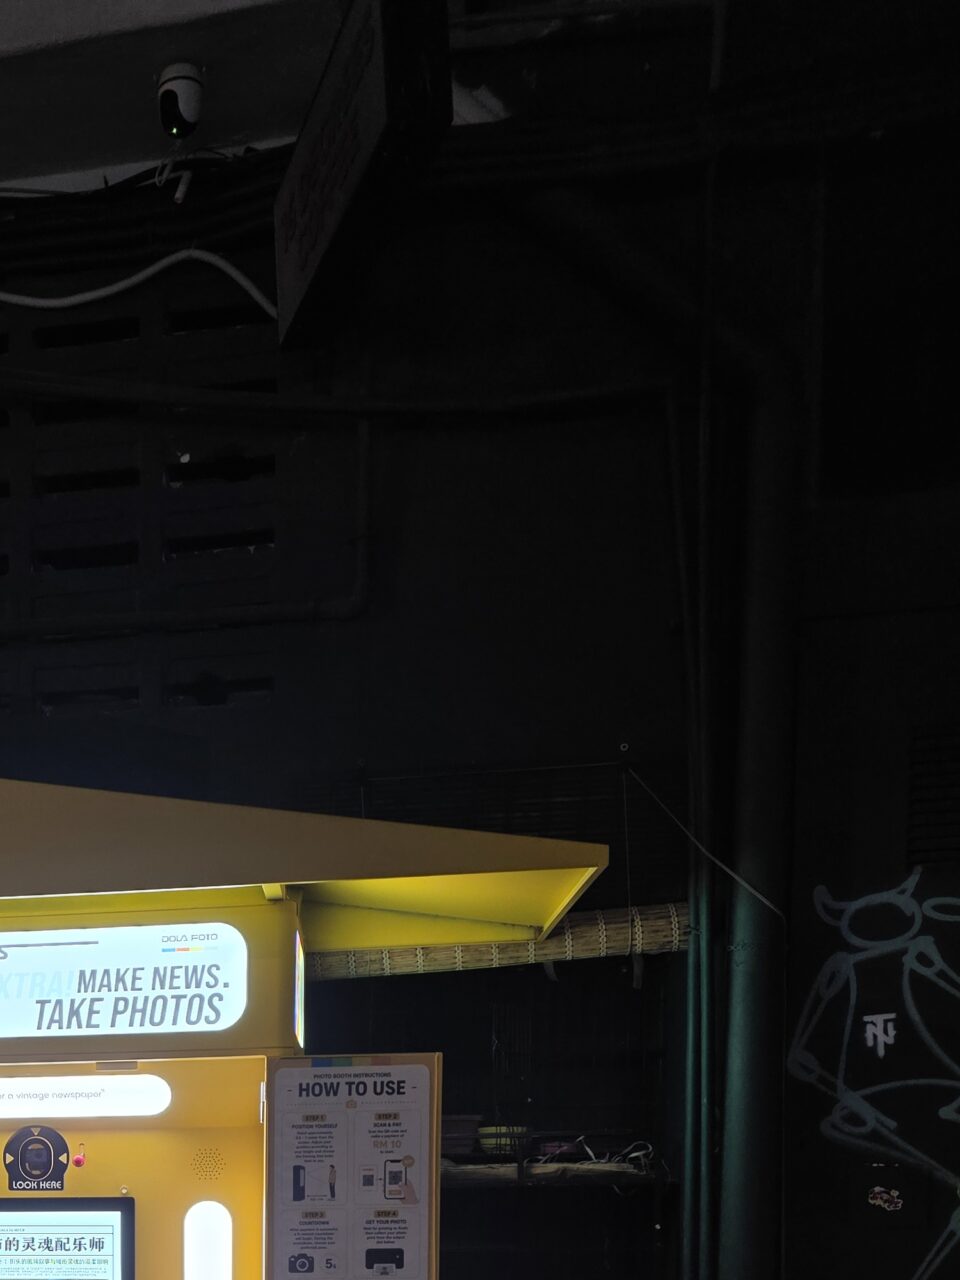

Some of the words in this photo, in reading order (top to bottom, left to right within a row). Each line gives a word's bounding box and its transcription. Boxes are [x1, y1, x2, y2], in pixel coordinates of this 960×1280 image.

[162, 935, 189, 943] DOLA
[191, 933, 219, 942] FOTO
[77, 967, 145, 995] MAKE
[151, 963, 230, 991] NEWS.
[35, 997, 105, 1031] TAKE
[110, 992, 225, 1028] PHOTOS
[298, 1081, 340, 1097] HOW
[345, 1081, 368, 1096] TO
[373, 1080, 406, 1096] USE
[17, 1090, 50, 1102] vintage
[373, 1140, 388, 1149] RM
[391, 1140, 402, 1149] 10
[12, 1180, 38, 1190] LOOK
[40, 1180, 62, 1189] HERE
